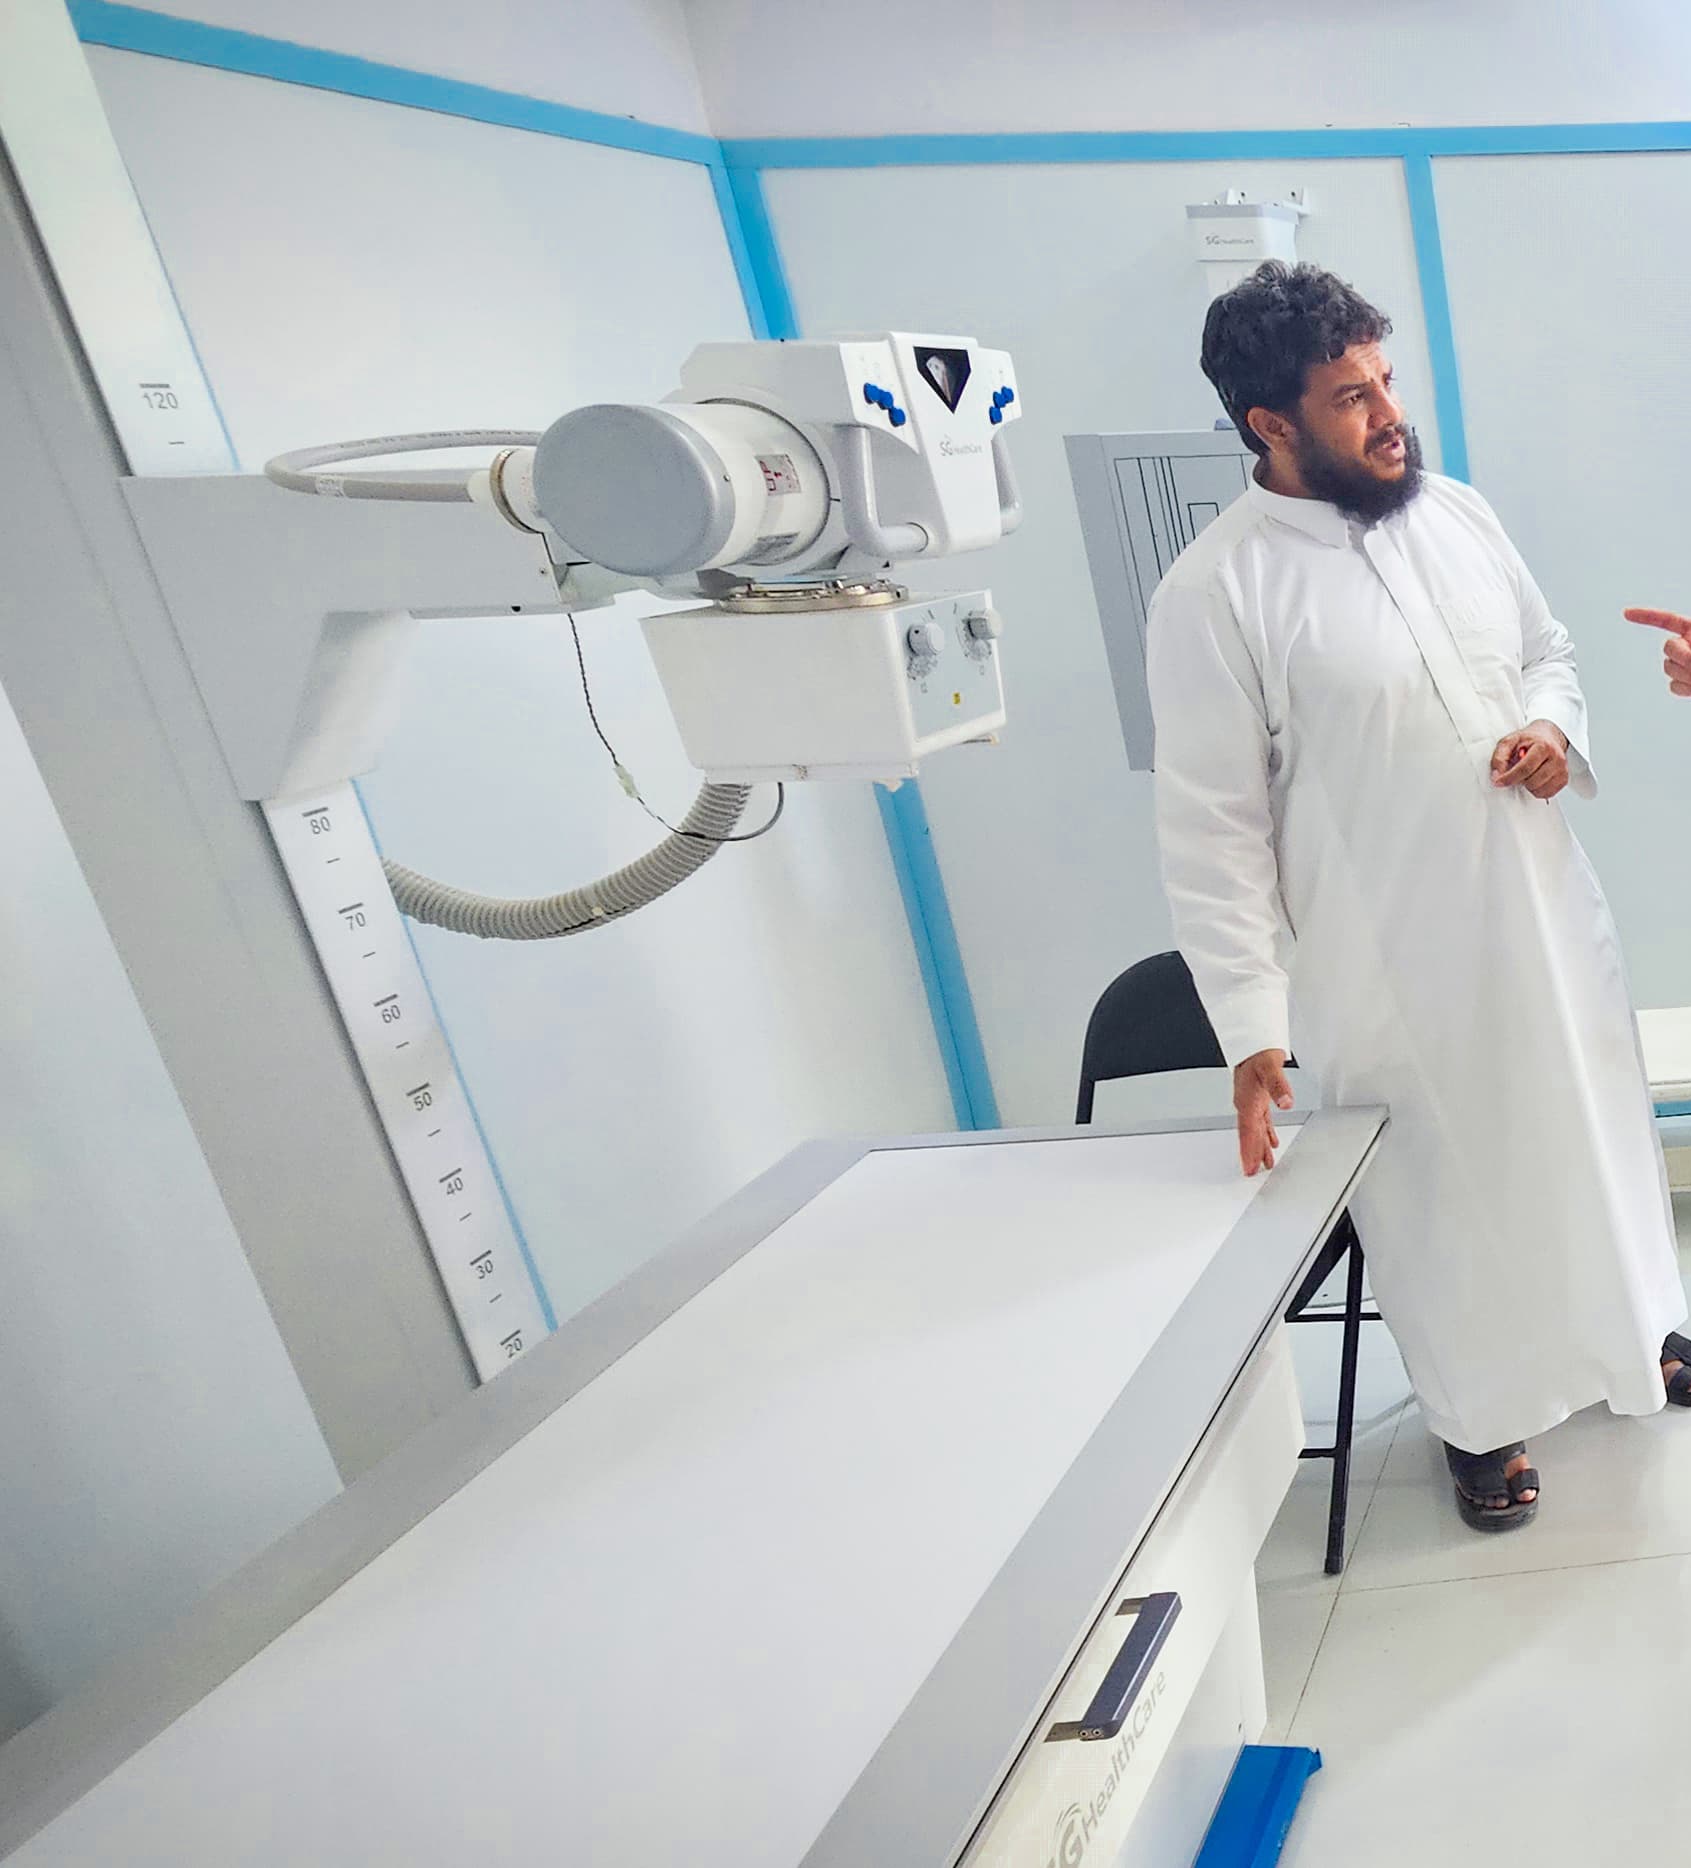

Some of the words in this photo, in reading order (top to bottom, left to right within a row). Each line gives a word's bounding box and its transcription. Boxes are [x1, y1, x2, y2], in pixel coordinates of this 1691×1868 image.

[142, 392, 179, 409] 120
[310, 816, 331, 834] 80
[345, 912, 366, 930] 70
[381, 1004, 401, 1024] 60
[413, 1091, 433, 1111] 50
[446, 1177, 464, 1196] 40
[475, 1259, 494, 1279] 30
[504, 1337, 523, 1358] 20
